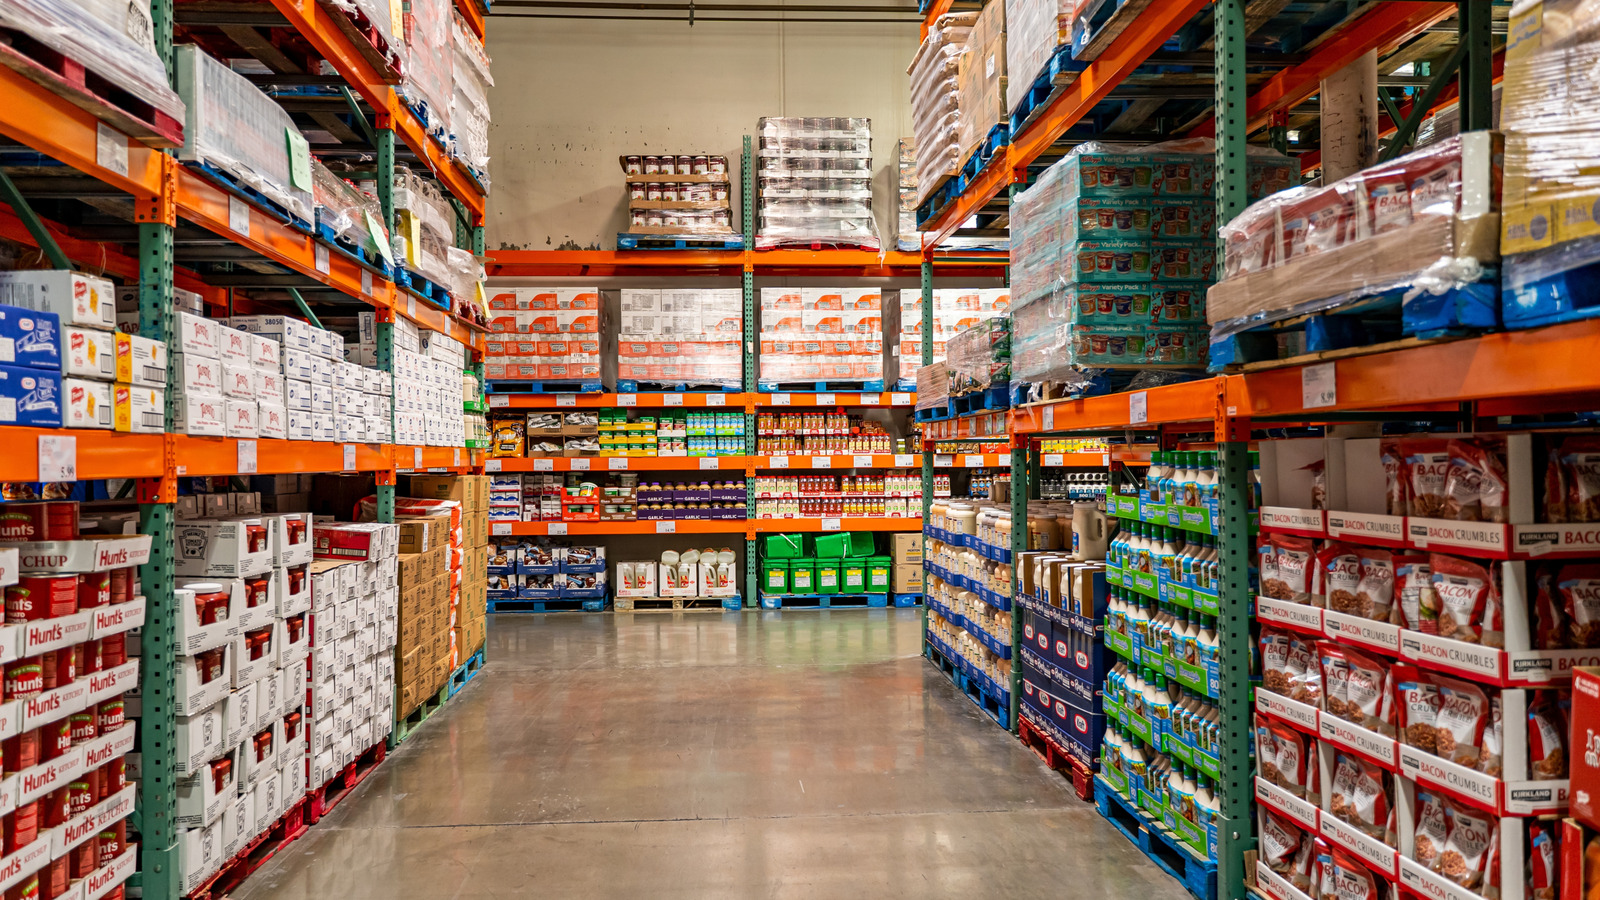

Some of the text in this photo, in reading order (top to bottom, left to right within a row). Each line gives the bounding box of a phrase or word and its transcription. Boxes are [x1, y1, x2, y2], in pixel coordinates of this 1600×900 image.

[265, 318, 283, 326] 38050
[1320, 391, 1335, 406] 8.99
[61, 464, 75, 479] 5.99
[1, 523, 35, 538] unt's
[1274, 513, 1320, 526] BACON CRUMBLES
[1344, 519, 1401, 535] BACON CRUMBLES
[1429, 527, 1500, 544] BACON CRUMBLES
[1521, 533, 1558, 541] KIRKLAND
[99, 548, 128, 567] Hunt's
[96, 608, 123, 630] Hunt's
[1272, 606, 1319, 626] BACON CRUMBLES
[29, 623, 63, 647] Hunt's
[1341, 623, 1398, 646] BACON CRUMBLES
[1421, 643, 1495, 670] BACON CRUMBLES
[1515, 659, 1552, 667] KIRKLAND
[1558, 656, 1600, 671] BACO
[5, 676, 43, 693] Hunt's
[90, 670, 116, 694] Hunt's
[27, 691, 60, 719] Hunt's
[1269, 699, 1315, 725] BACON CRUMBLES
[1335, 727, 1392, 759] BACON CRUMBLES
[86, 741, 113, 768] Hunt's
[23, 764, 57, 795] Hunt's
[1420, 761, 1492, 799] BACON CRUMBLES
[1512, 790, 1550, 798] KIRKLAND
[1269, 791, 1314, 824] BACON CRUMBLES
[63, 798, 130, 847] Hunt's KETCHUP
[1336, 829, 1392, 868] BACON CRUMBLES
[0, 858, 22, 880] unt's
[88, 864, 115, 895] Hunt's
[1420, 877, 1446, 900] BACON
